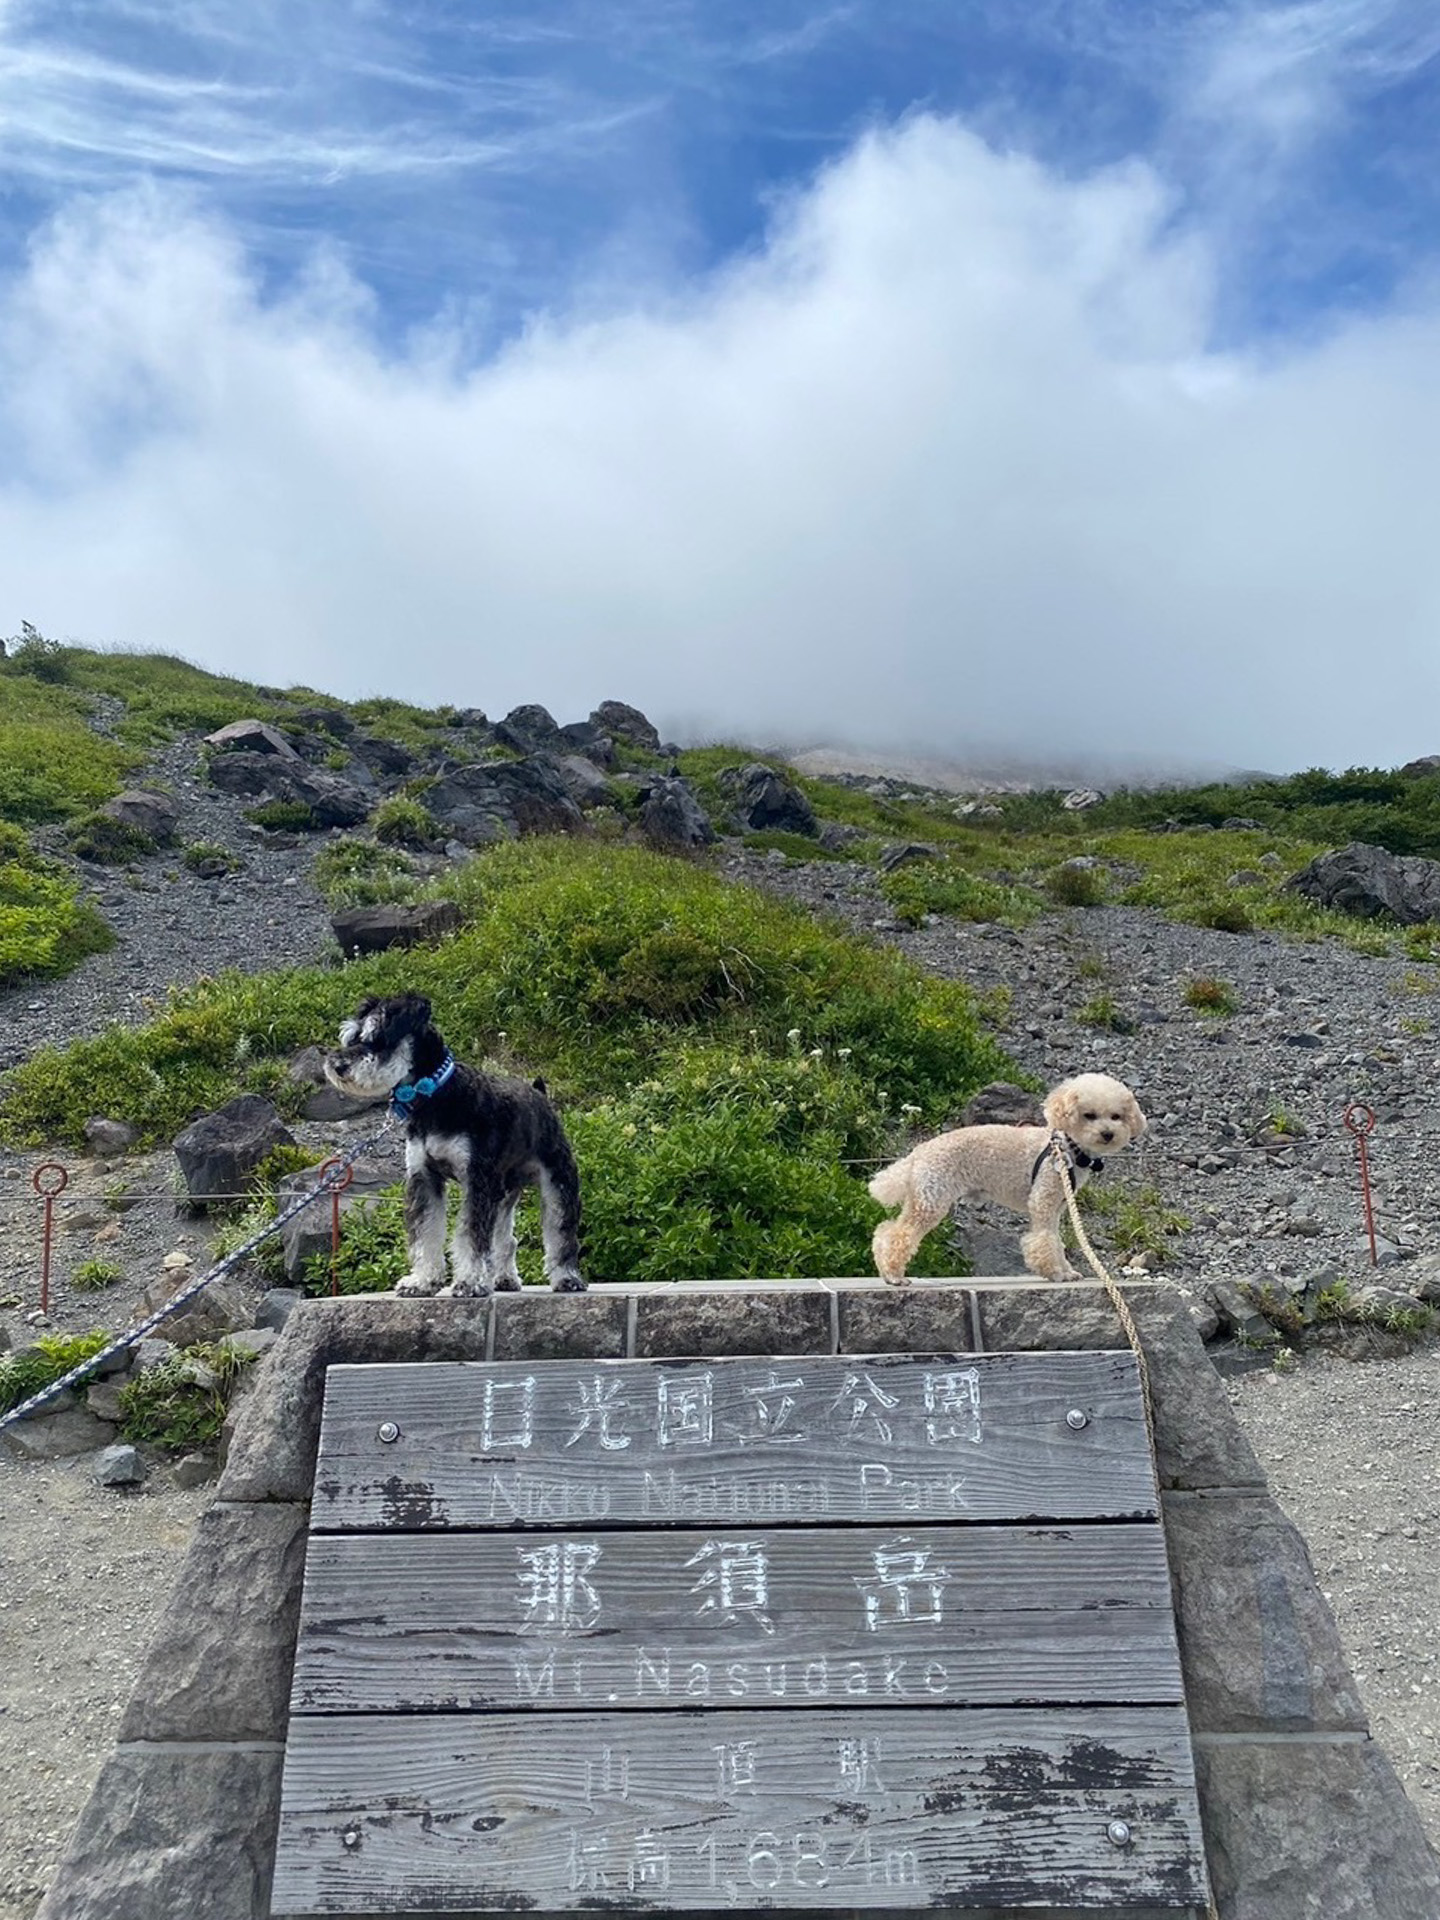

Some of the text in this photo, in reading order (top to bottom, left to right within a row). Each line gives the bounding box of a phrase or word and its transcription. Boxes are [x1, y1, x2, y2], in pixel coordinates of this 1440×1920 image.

[480, 1367, 983, 1450] 日光国立公園
[489, 1472, 611, 1518] Nikko
[860, 1464, 968, 1510] Park
[515, 1535, 952, 1639] 那須岳
[583, 1737, 885, 1801] 山頂駅
